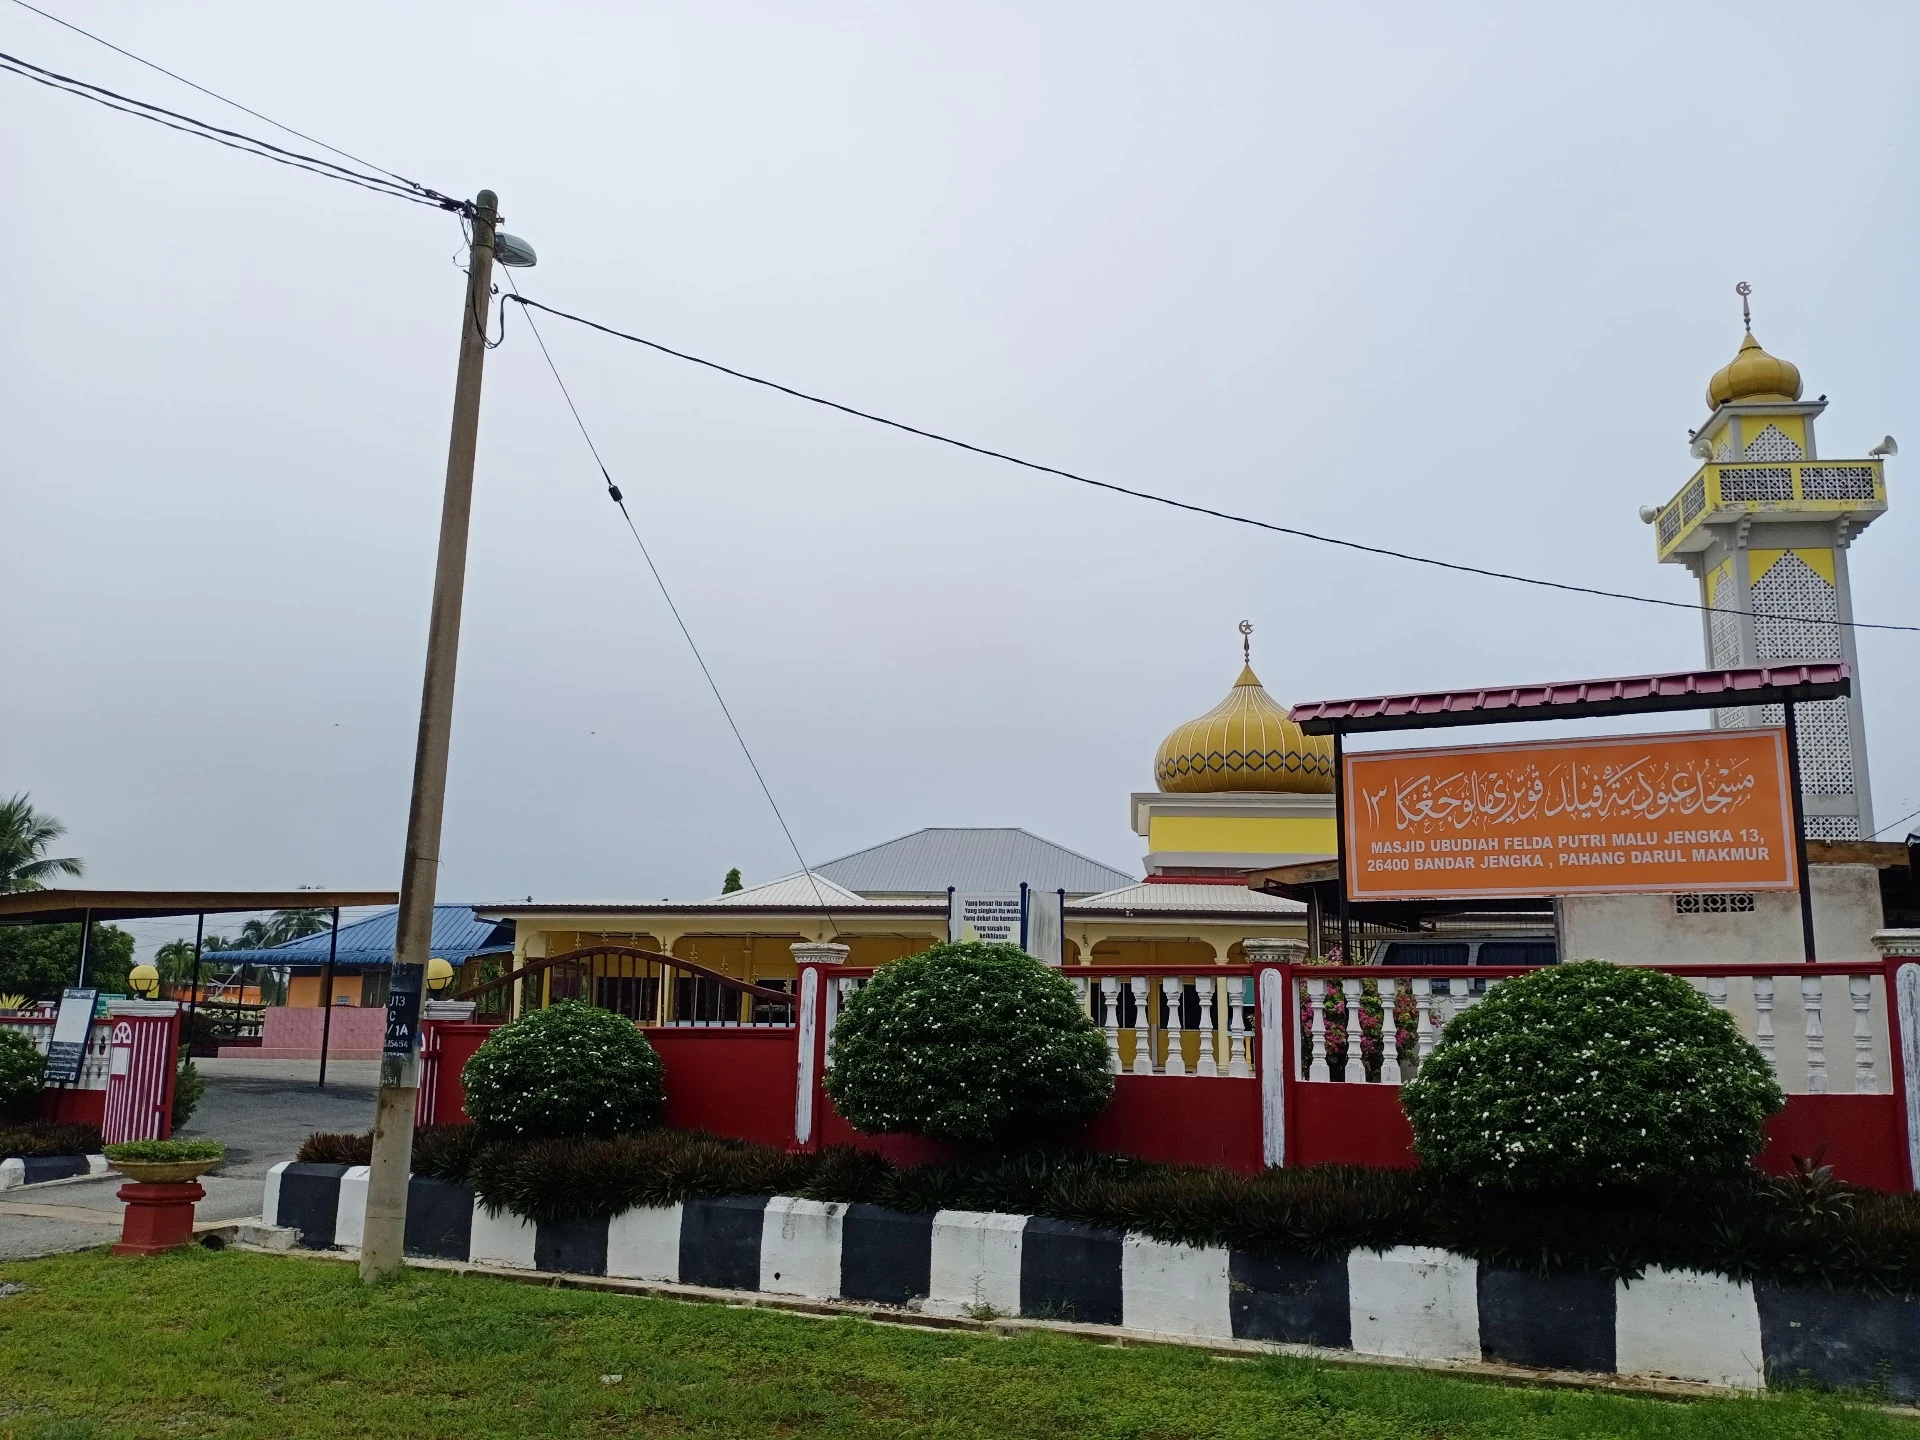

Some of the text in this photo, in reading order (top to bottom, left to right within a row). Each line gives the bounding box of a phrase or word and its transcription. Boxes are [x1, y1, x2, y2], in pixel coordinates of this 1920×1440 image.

[1371, 828, 1765, 854] MASJID UBUDIAH FELDA PUTRI MALU JENGKA 13,
[1367, 859, 1410, 872] 26400
[1414, 856, 1475, 871] BANDAR
[1480, 854, 1543, 869] JENGKA
[1559, 851, 1625, 866] PAHANG
[1631, 849, 1687, 864] DARUL
[1692, 847, 1770, 862] MAKMUR
[389, 995, 406, 1007] J13
[389, 1010, 397, 1022] C
